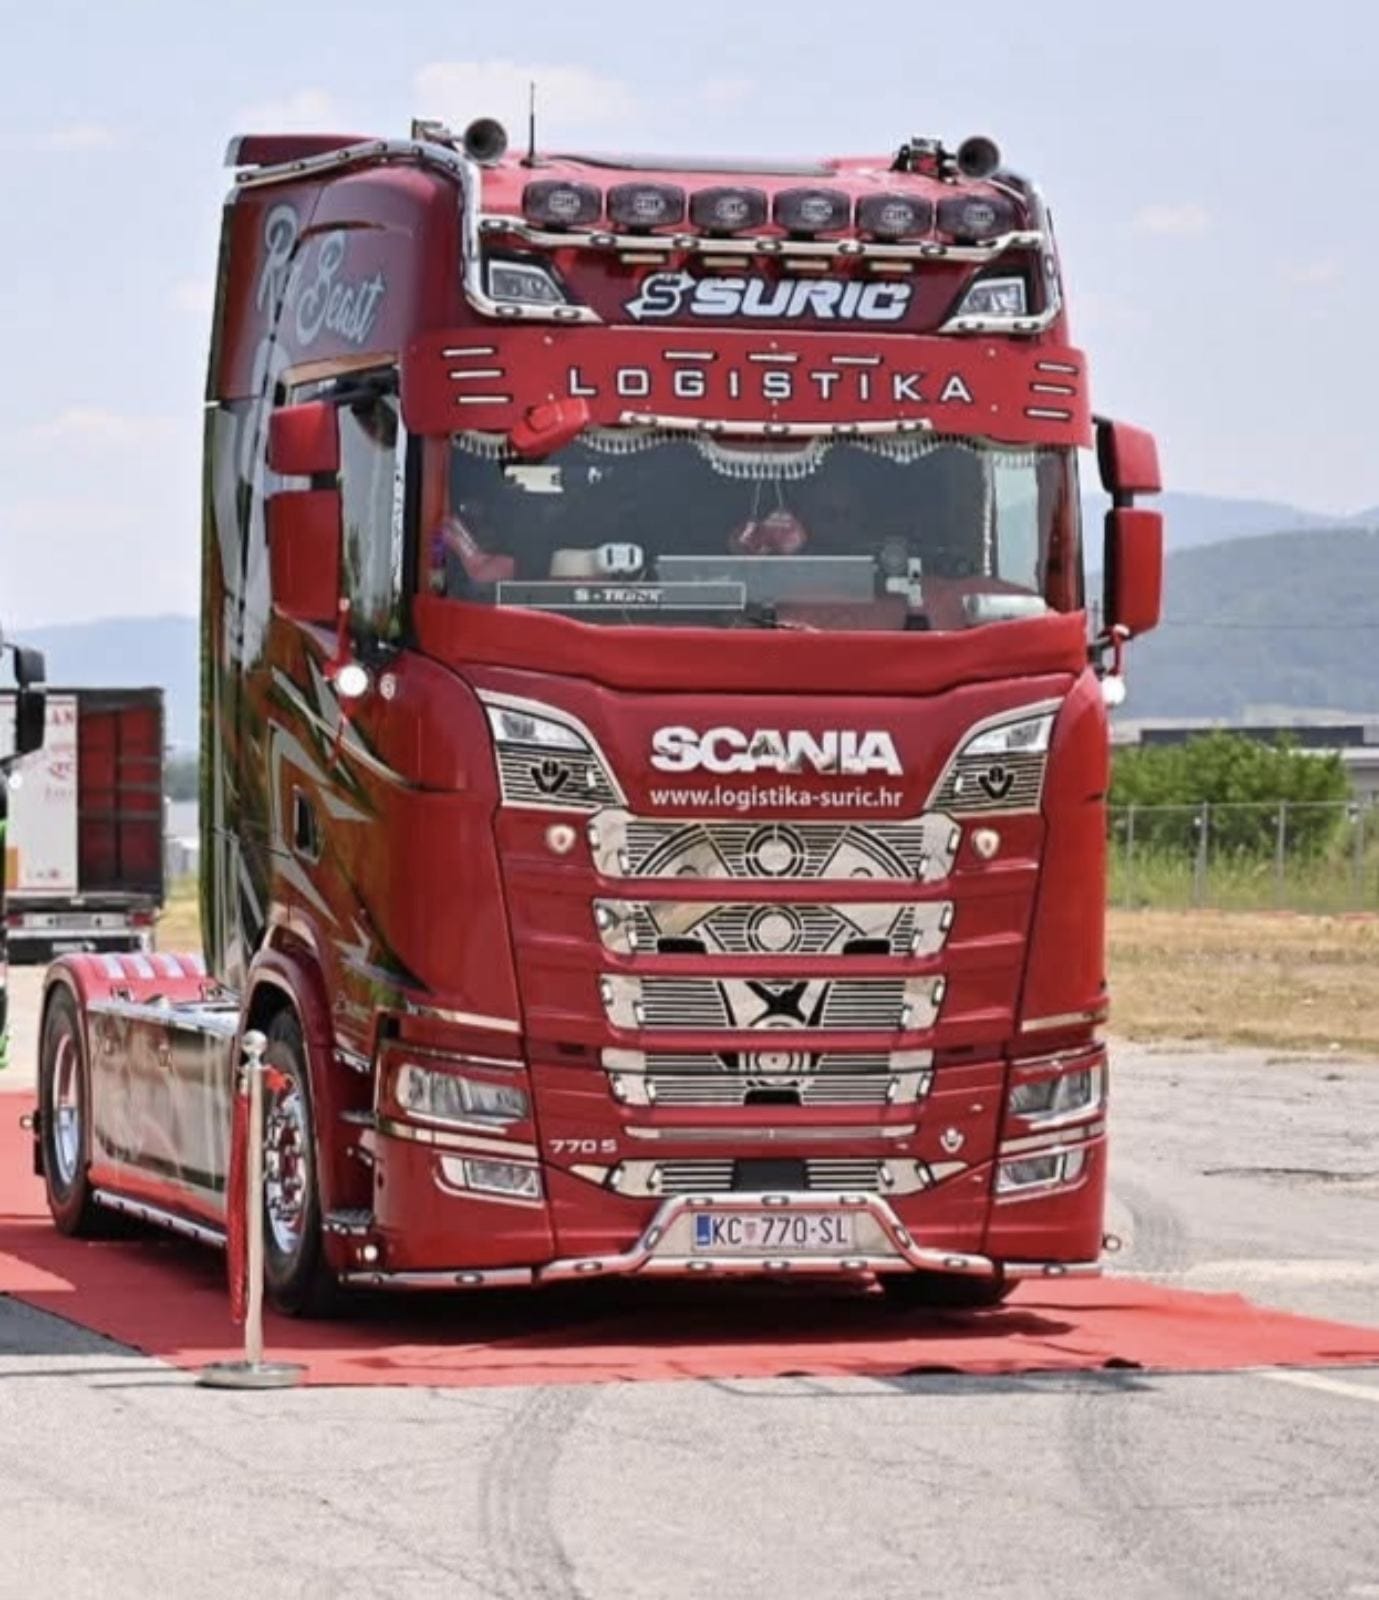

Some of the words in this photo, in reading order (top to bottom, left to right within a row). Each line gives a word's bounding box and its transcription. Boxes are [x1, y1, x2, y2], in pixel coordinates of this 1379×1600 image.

[690, 277, 912, 320] SURIC
[569, 366, 973, 404] LOGISTIKA
[650, 725, 904, 776] SCANIA
[650, 785, 904, 812] www.logistika-suric.hr
[549, 1139, 597, 1154] 770
[601, 1139, 618, 1154] S
[712, 1216, 743, 1245] KC
